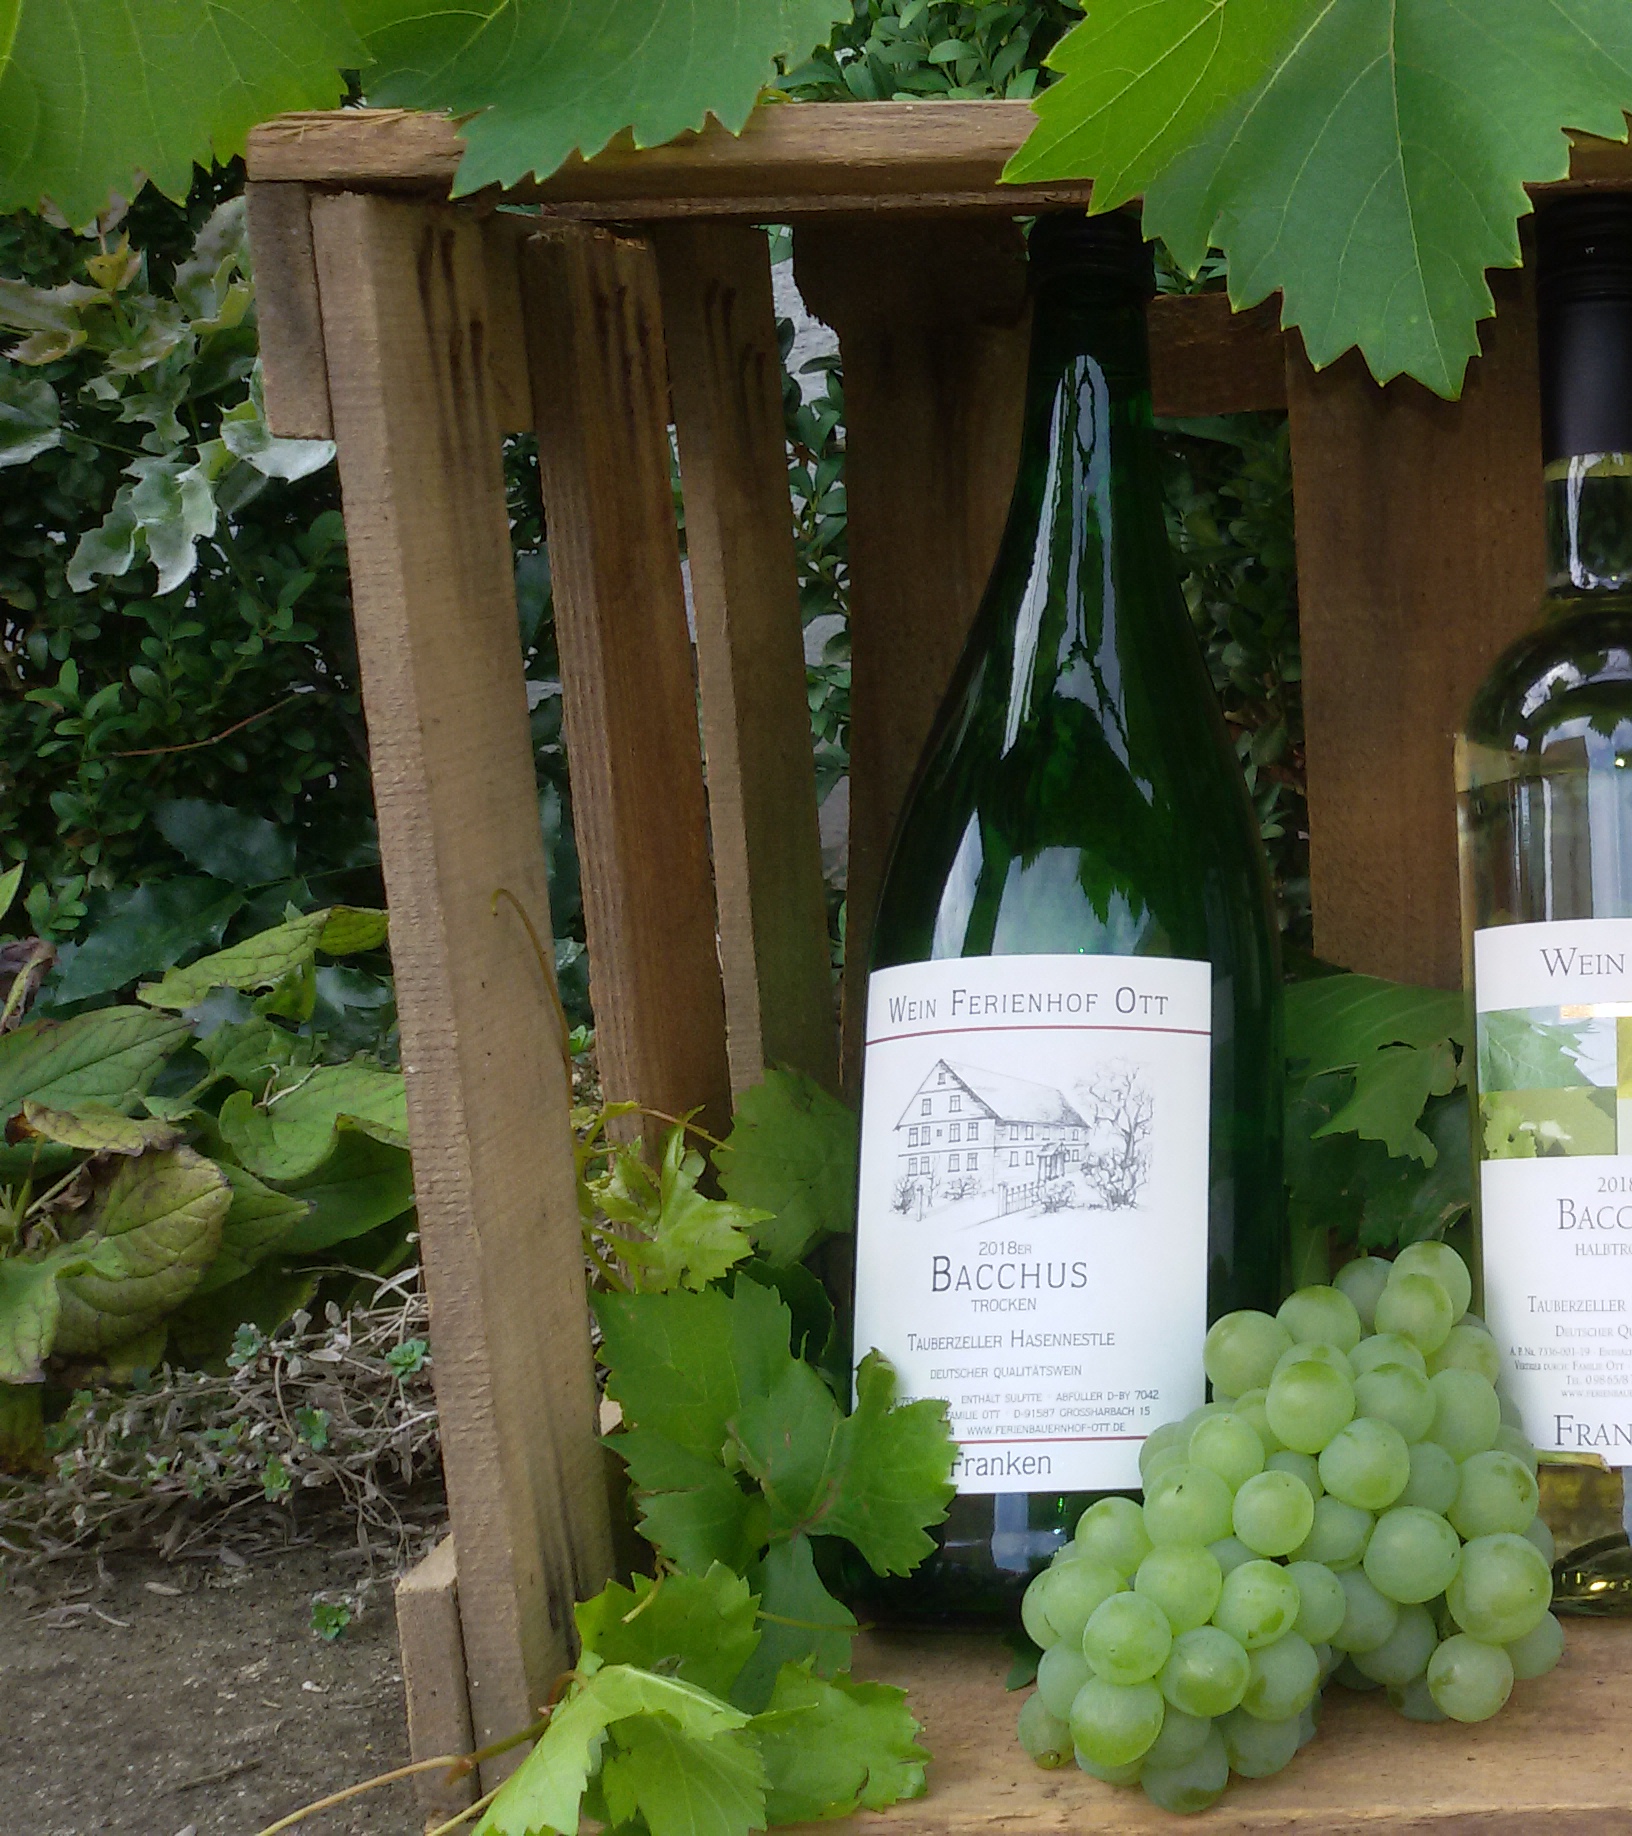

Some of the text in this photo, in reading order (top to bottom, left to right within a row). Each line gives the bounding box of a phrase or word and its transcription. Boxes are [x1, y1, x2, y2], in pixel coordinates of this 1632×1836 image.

[1540, 946, 1625, 977] WEIN
[889, 986, 1170, 1023] WEIN FERIENHOF OTT
[978, 1241, 1032, 1255] 2018ER
[931, 1255, 1089, 1292] BACCHUS
[971, 1297, 1038, 1312] TROCKEN
[1527, 1295, 1626, 1313] TAUBERZELLER
[907, 1330, 1116, 1351] TAUBERZELLER HASENNESTLE
[930, 1364, 1082, 1380] DEUTSCHER QUALITÄTSWEIN
[1135, 1389, 1160, 1400] 7042
[1140, 1406, 1151, 1416] 15
[950, 1451, 1052, 1477] Franken
